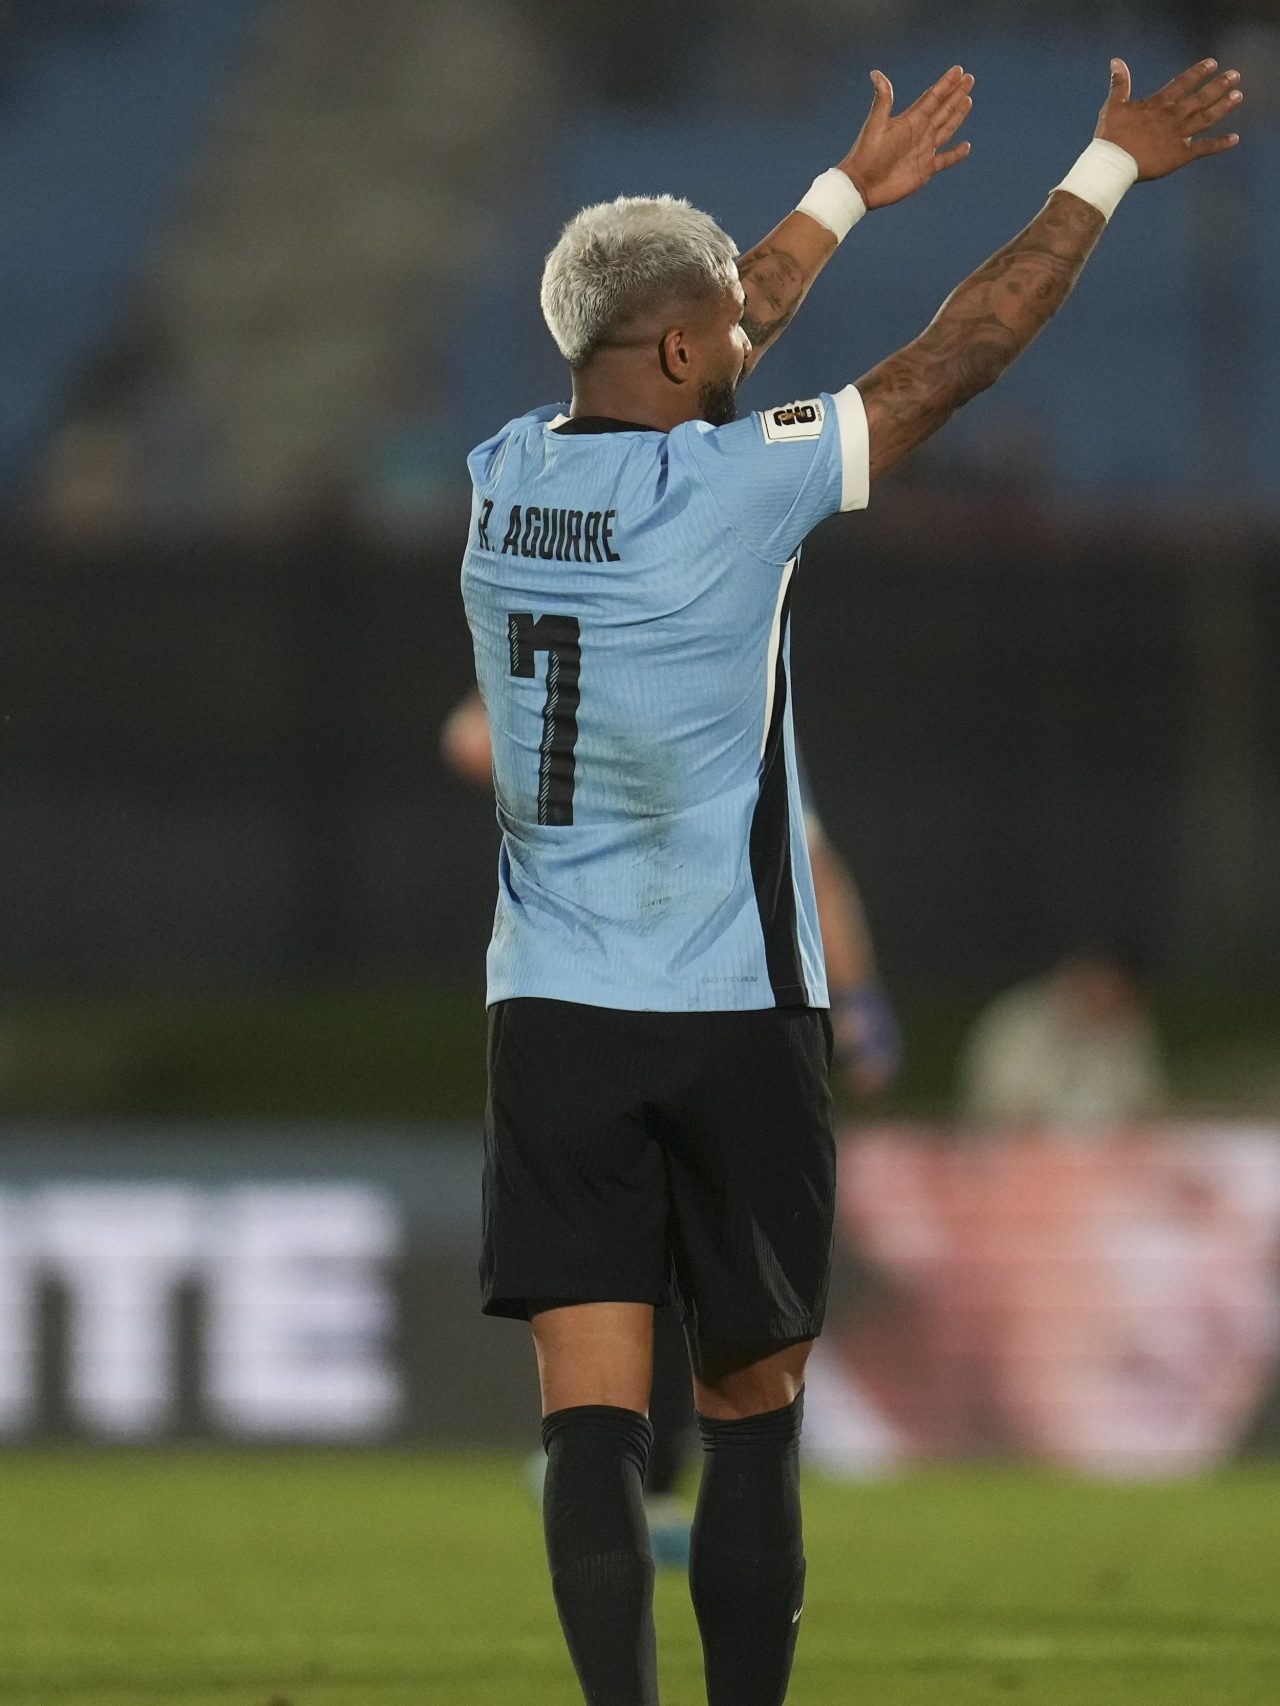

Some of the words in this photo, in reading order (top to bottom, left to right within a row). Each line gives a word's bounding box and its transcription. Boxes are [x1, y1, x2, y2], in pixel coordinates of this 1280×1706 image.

[478, 499, 495, 552] R.
[502, 505, 621, 562] AGUIRRE
[508, 613, 581, 826] 7
[0, 1178, 402, 1442] TE
